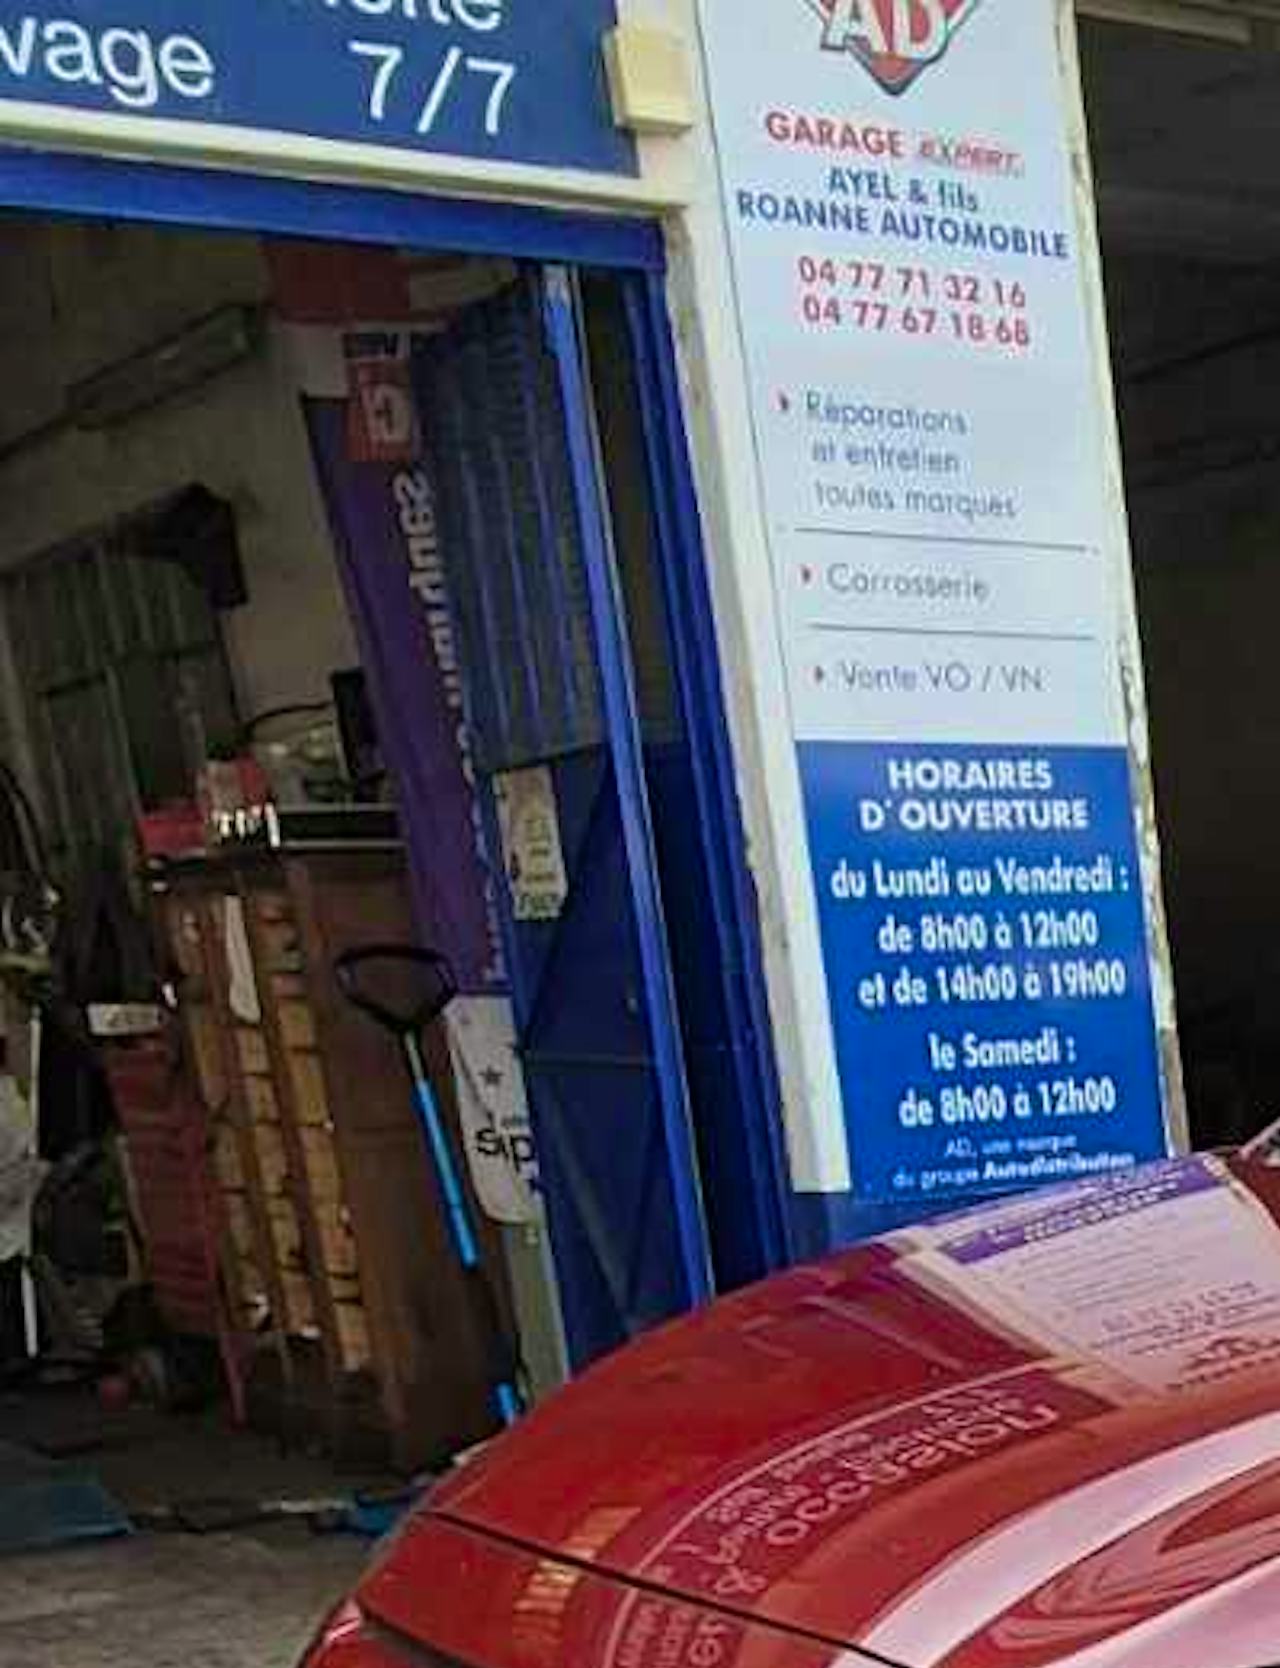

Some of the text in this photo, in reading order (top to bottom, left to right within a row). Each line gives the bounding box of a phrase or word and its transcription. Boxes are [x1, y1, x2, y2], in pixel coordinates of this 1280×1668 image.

[349, 40, 516, 135] 7/7
[765, 111, 903, 158] GARAGE
[828, 166, 897, 201] AYEL
[908, 178, 928, 204] &
[736, 189, 1070, 260] ROANNE AUTOMOBILE
[798, 255, 1026, 309] 04 77 71 32 16
[803, 294, 1030, 348] 04 77 67 18 68
[905, 488, 1018, 523] marques
[827, 562, 989, 602] Carrosserie
[926, 660, 971, 690] VO
[1002, 664, 1045, 692] VN
[887, 757, 1053, 792] HORAIRES
[831, 857, 866, 899] du
[872, 857, 950, 899] Lundi
[955, 864, 990, 897] au
[994, 854, 1115, 895] Vendredi
[878, 912, 914, 954] de
[919, 913, 987, 952] 8h00
[1019, 908, 1098, 949] 12h00
[857, 973, 886, 1009] et
[892, 967, 929, 1005] de
[935, 964, 1016, 1003] 14h00
[1047, 959, 1127, 998] 19h00
[928, 1031, 957, 1071] le
[962, 1027, 1060, 1070] Samedi
[897, 1087, 934, 1129] de
[939, 1086, 1008, 1126] 8h00
[1036, 1076, 1117, 1116] 12h00
